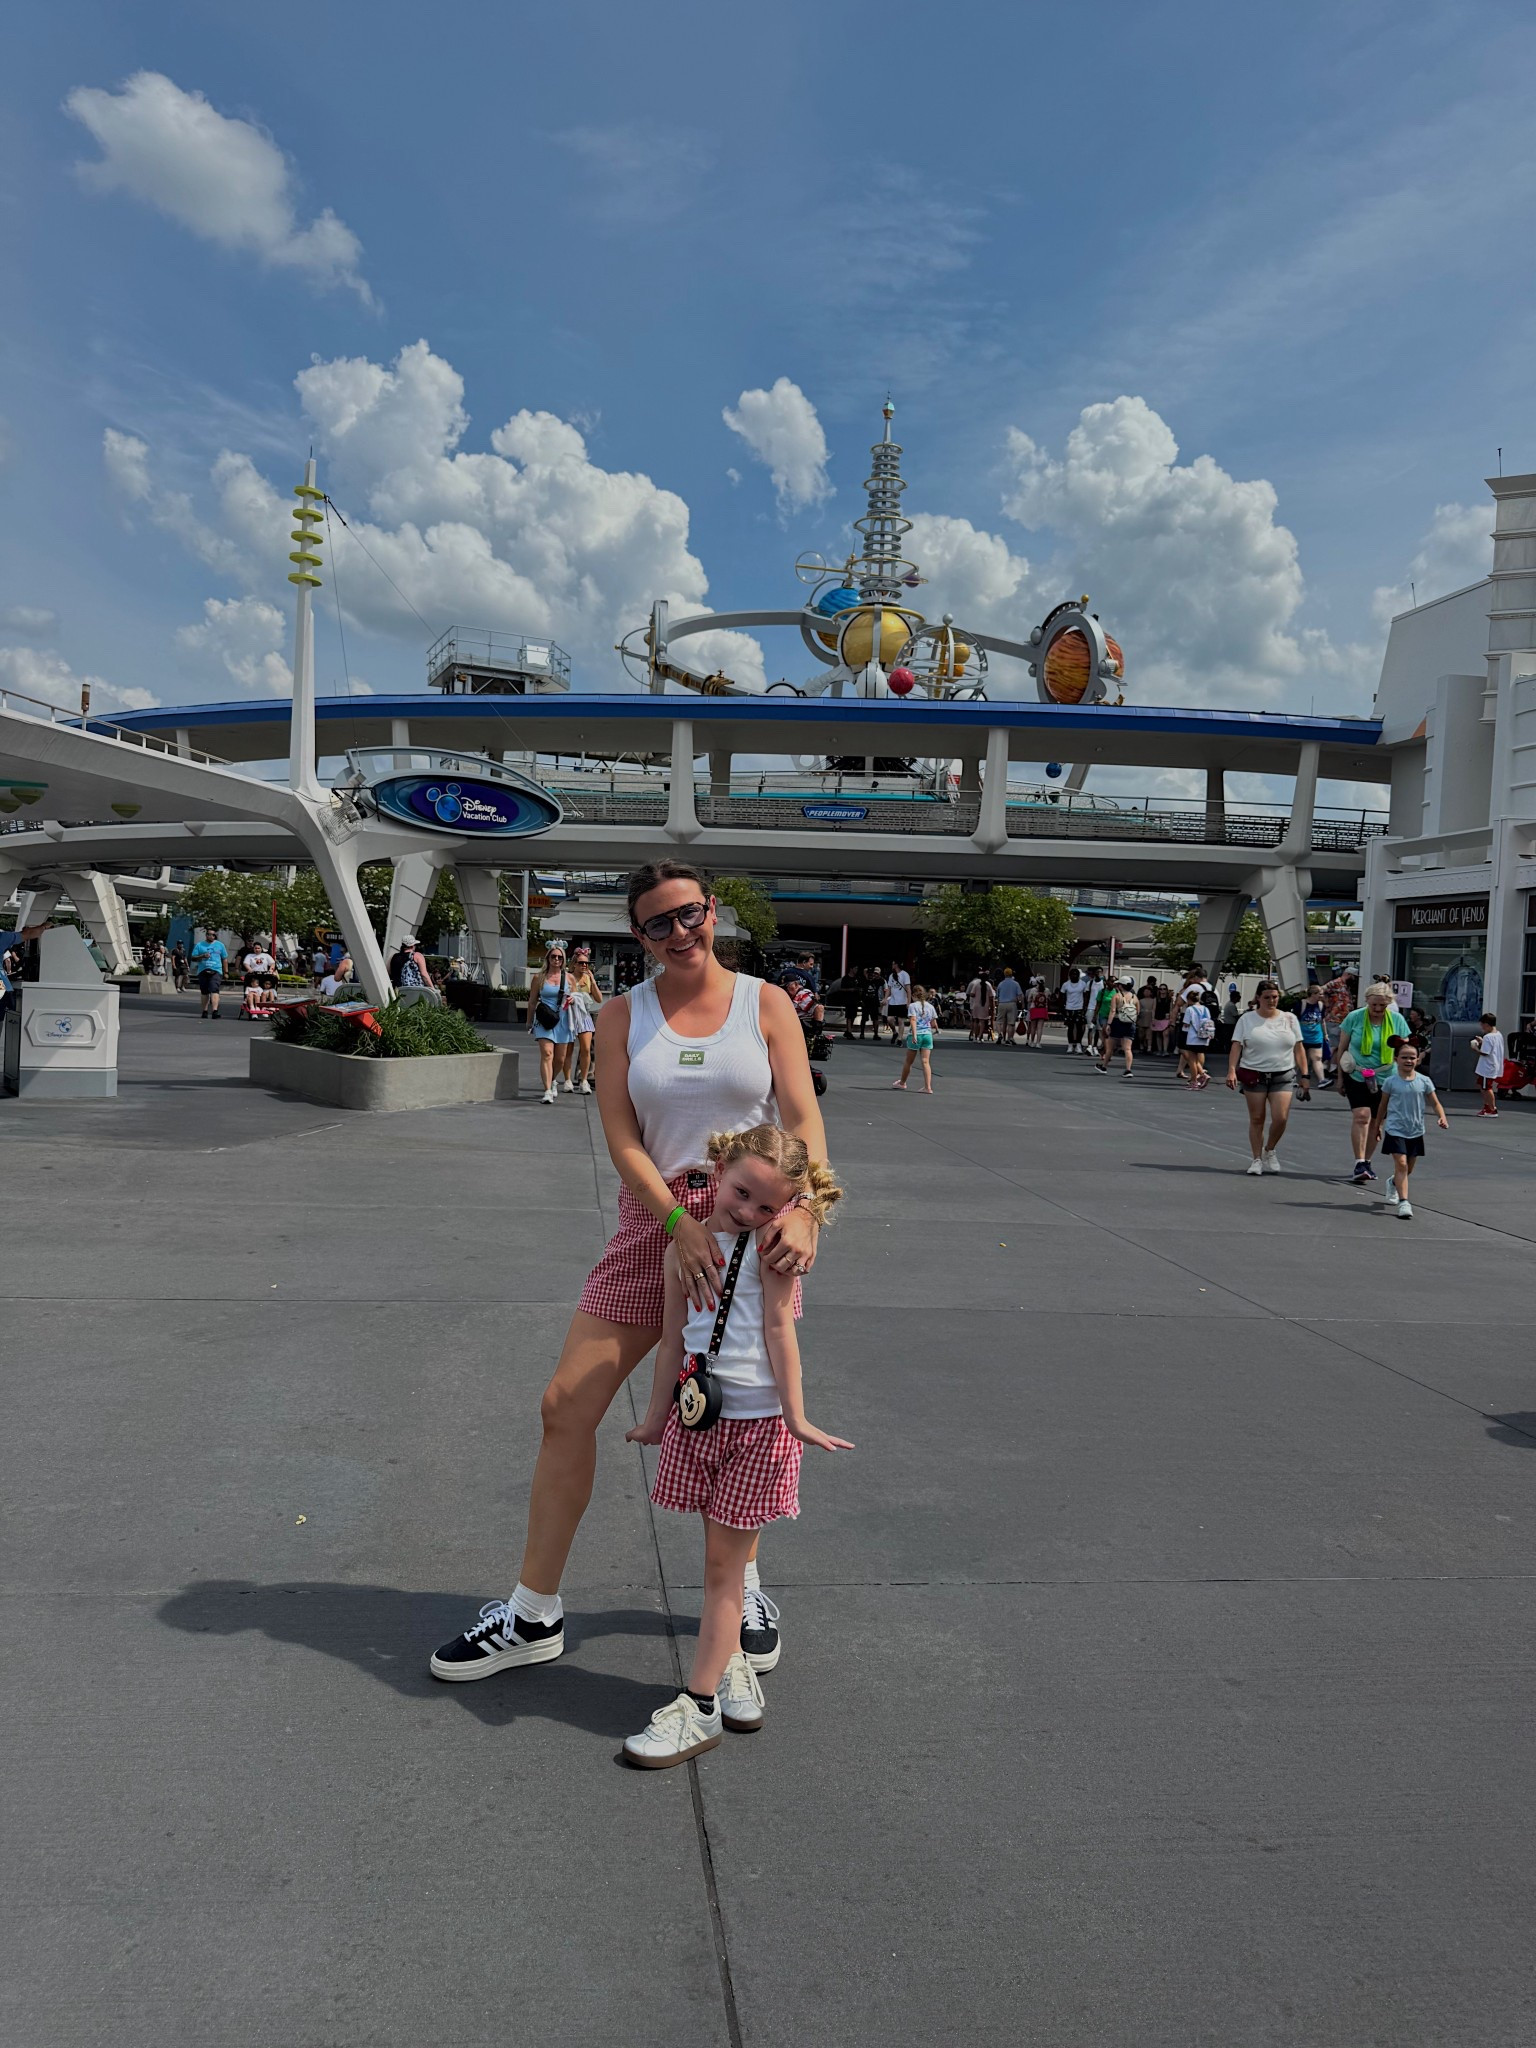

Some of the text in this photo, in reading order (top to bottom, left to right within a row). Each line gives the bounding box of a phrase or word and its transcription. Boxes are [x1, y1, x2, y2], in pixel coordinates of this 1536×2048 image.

[462, 813, 507, 823] Vacation Club
[808, 810, 861, 818] PEOPLEMOVER
[1411, 906, 1485, 928] MERCHANT OF VENUS
